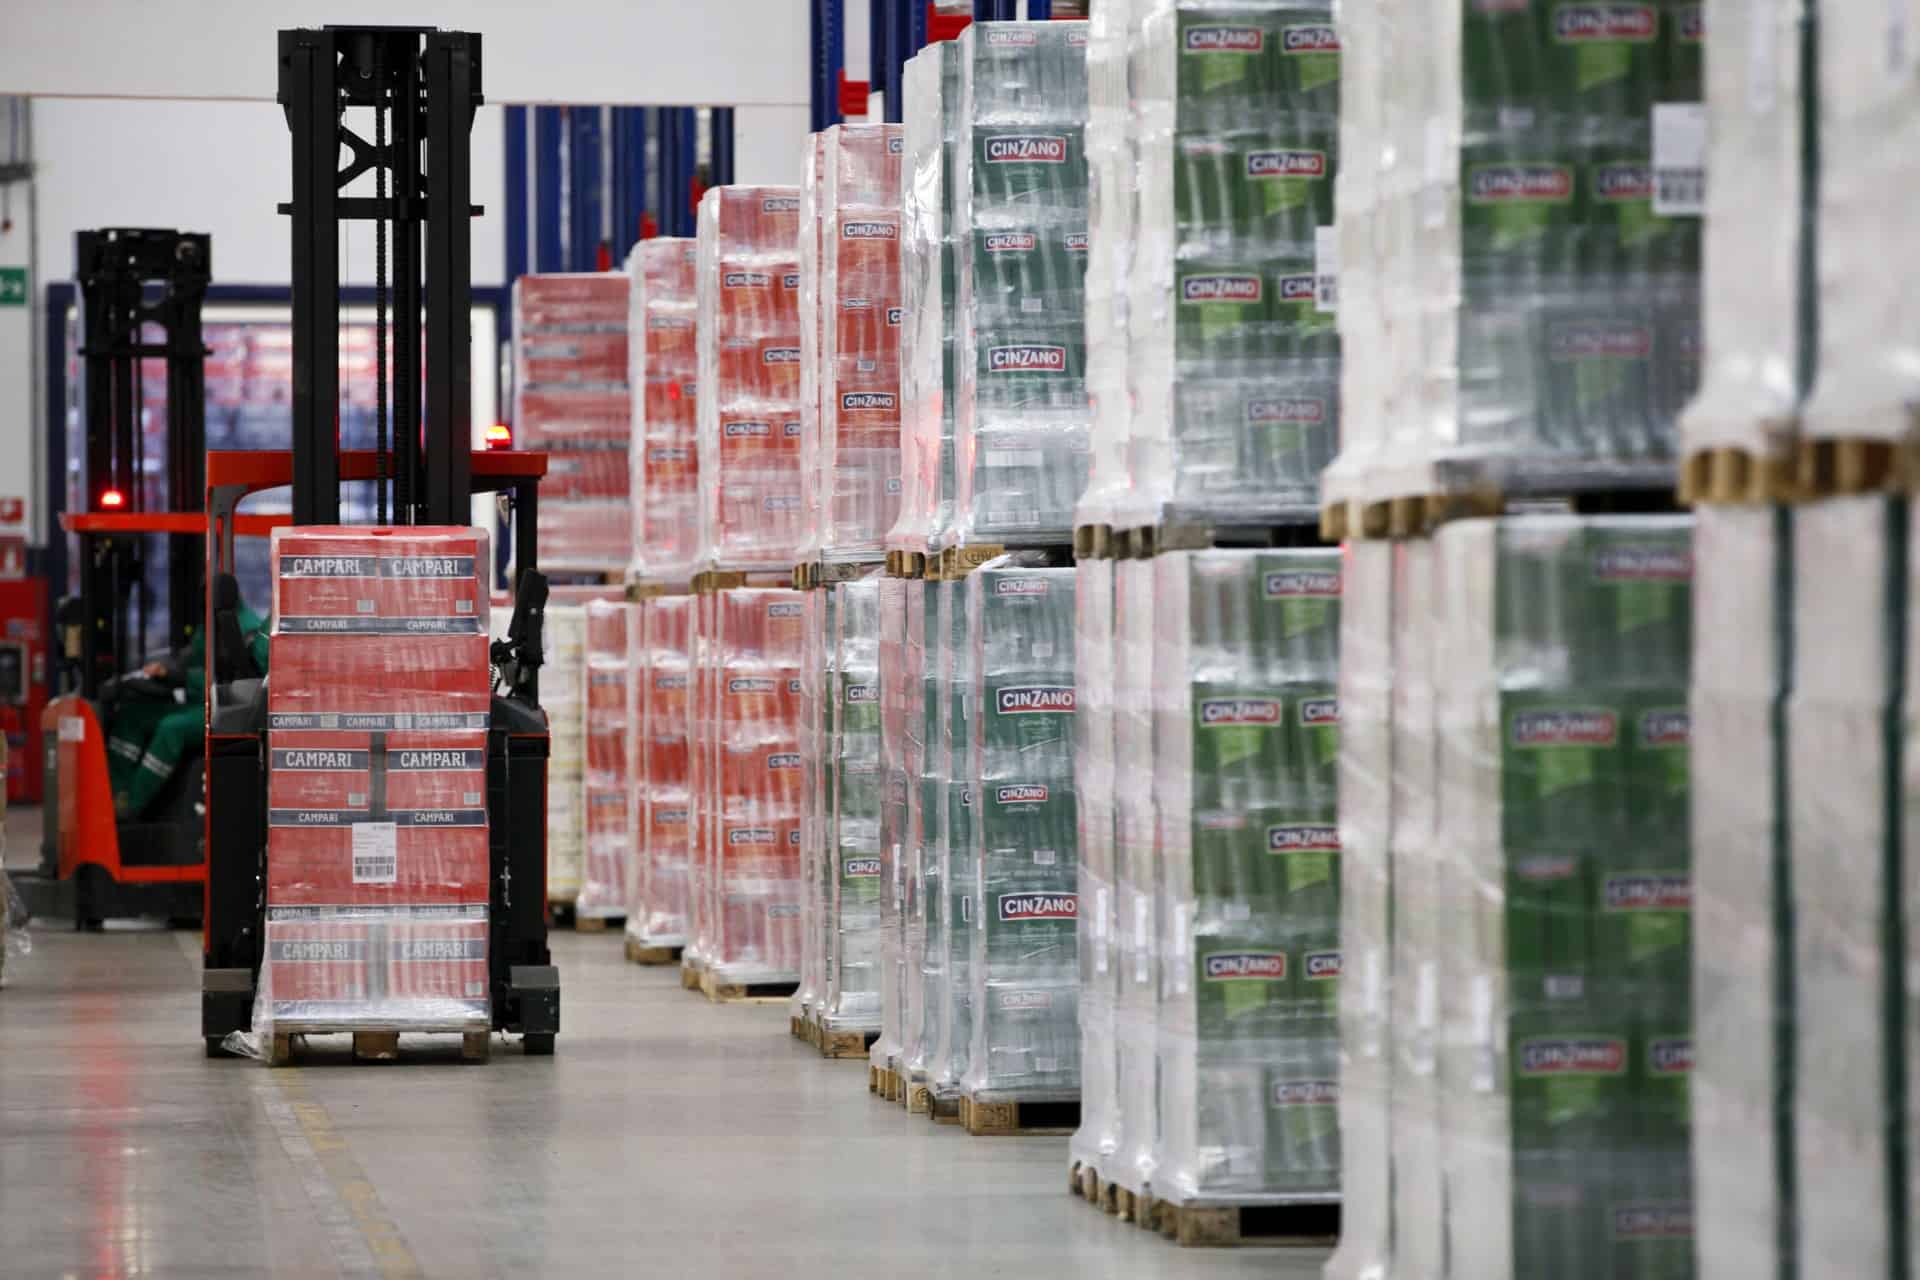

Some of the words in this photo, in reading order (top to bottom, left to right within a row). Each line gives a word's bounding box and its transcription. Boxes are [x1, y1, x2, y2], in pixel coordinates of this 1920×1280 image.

[1189, 29, 1258, 47] CINZANO
[990, 139, 1060, 157] CINZANO
[1251, 154, 1320, 172] CINZANO
[845, 224, 894, 237] CINZANO
[986, 234, 1032, 249] CINZANO
[1187, 278, 1256, 297] CINZANO
[993, 347, 1060, 366] CINZANO
[845, 395, 894, 408] CINZANO
[293, 558, 361, 575] CAMPARI
[391, 559, 459, 576] CAMPARI
[1270, 574, 1340, 592] CINZANO
[306, 620, 348, 631] CAMPARI
[1002, 688, 1074, 708] CINZANO
[1204, 702, 1275, 719] CINZANO
[285, 751, 352, 768] CAMPARI
[400, 752, 467, 768] CAMPARI
[999, 785, 1045, 799] CINZANO
[298, 812, 339, 823] CAMPARI
[413, 812, 455, 823] CAMPARI
[1004, 896, 1077, 914] CINZANO
[282, 942, 350, 959] CAMPARI
[402, 942, 469, 959] CAMPARI
[1210, 955, 1281, 975] CINZANO
